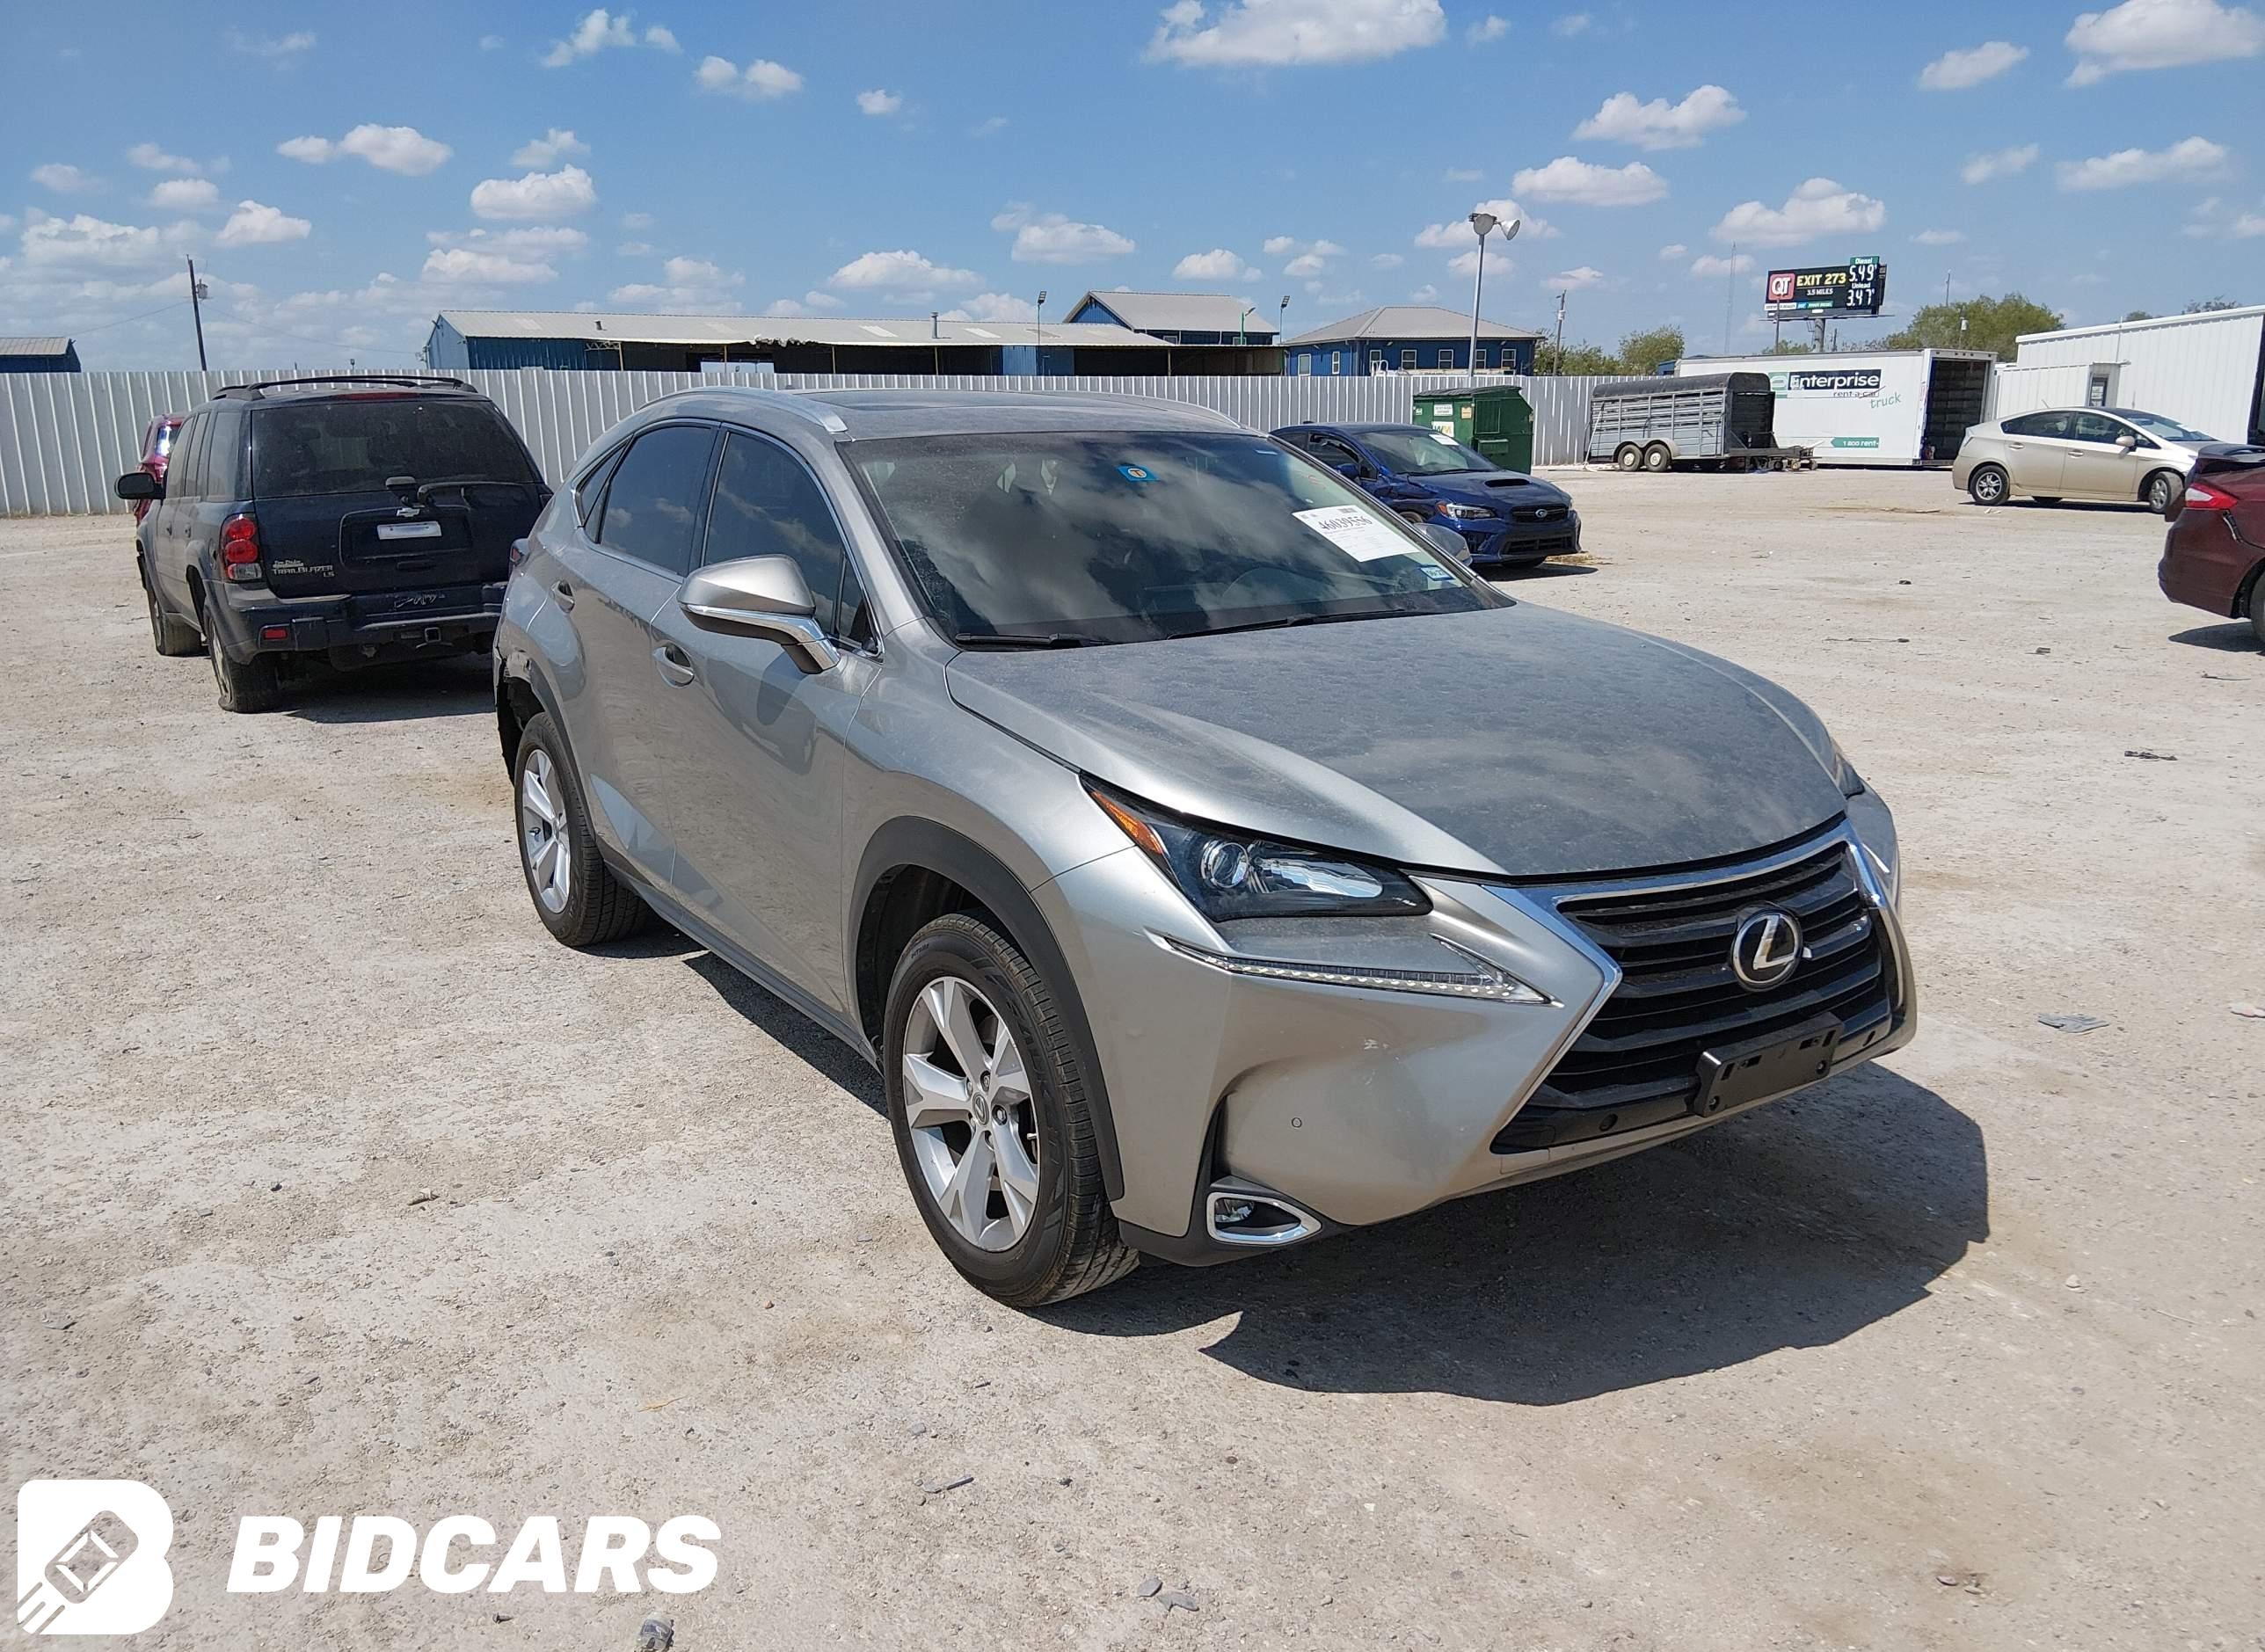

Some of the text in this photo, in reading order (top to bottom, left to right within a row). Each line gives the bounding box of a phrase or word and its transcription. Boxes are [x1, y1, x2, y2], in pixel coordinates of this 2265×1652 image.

[1771, 277, 1791, 296] QT
[1796, 273, 1846, 287] EXIT 273
[1789, 372, 1879, 391] Enterprise
[1870, 392, 1902, 409] truck
[271, 565, 333, 575] TRAILBLAZER
